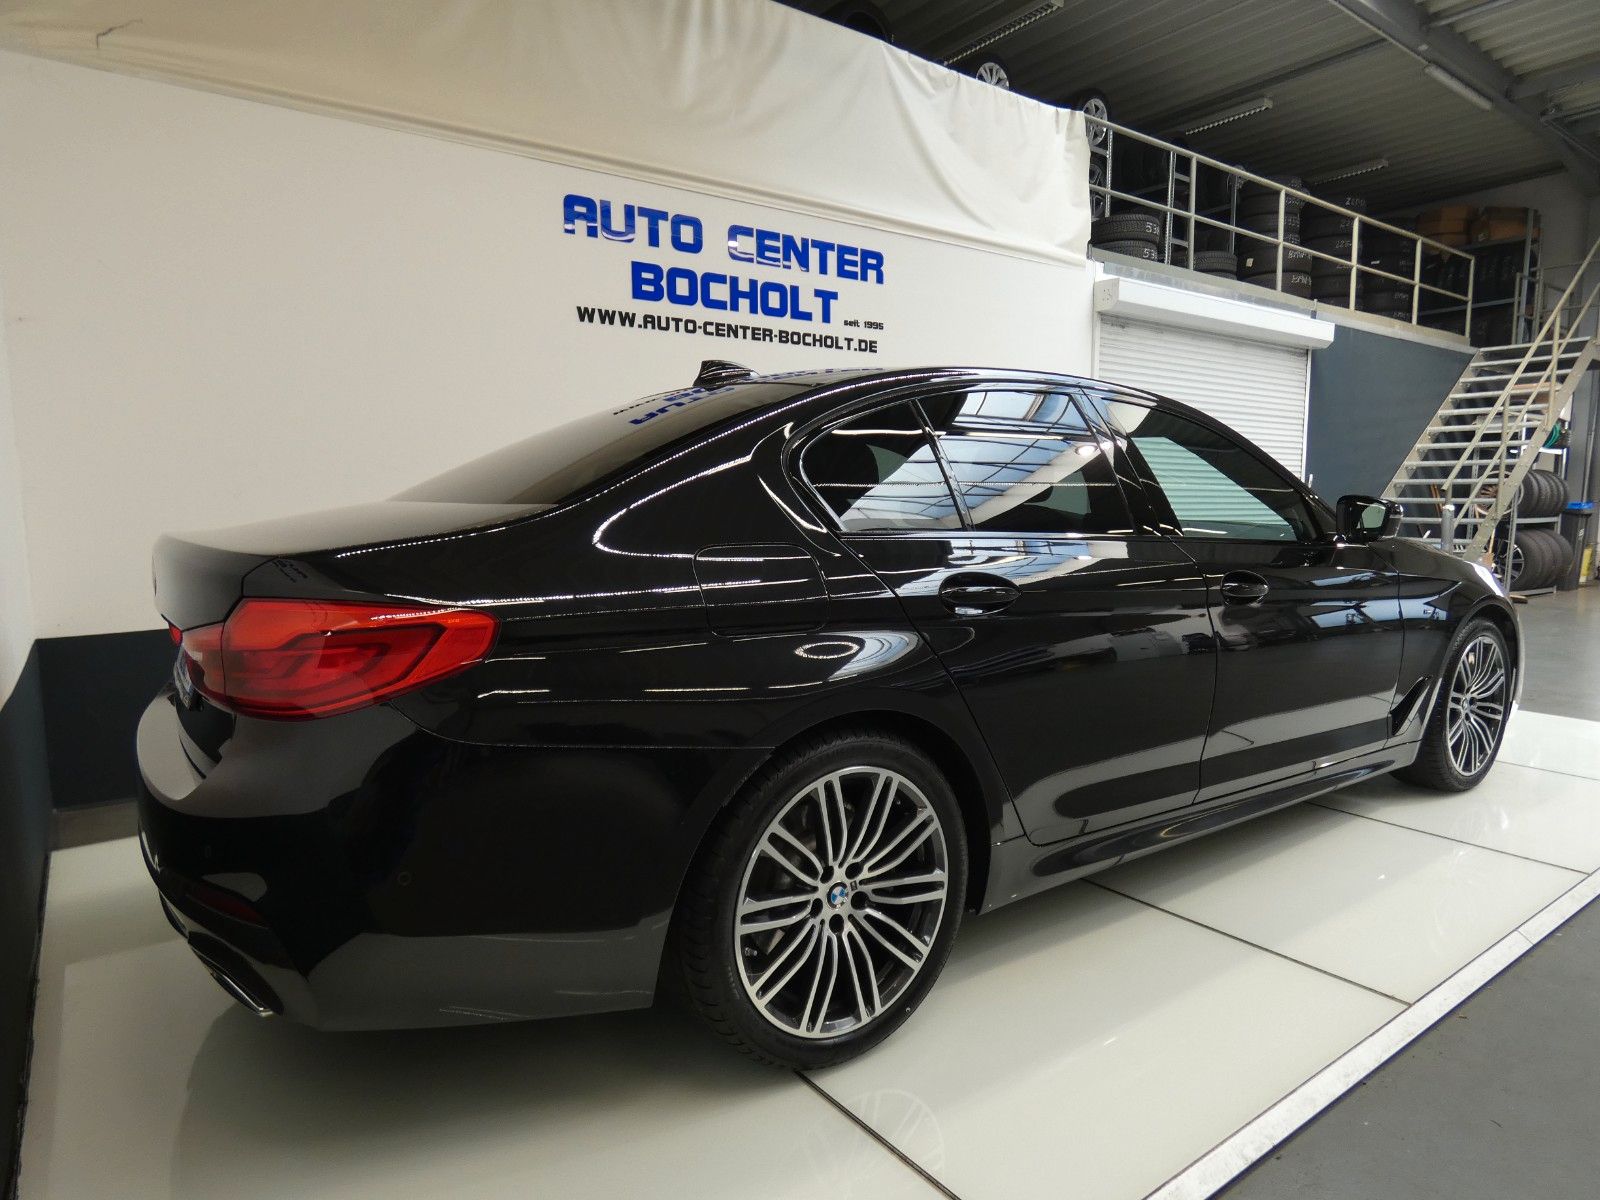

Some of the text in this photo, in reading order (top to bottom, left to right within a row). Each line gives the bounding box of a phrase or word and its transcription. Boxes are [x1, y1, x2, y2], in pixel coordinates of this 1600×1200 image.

[563, 194, 885, 284] AUTO CENTER
[631, 261, 838, 324] BOCHOLT
[576, 306, 878, 354] WWW.AUTO-CENTER-BOCHOLT.DE
[843, 319, 884, 331] seit 1995
